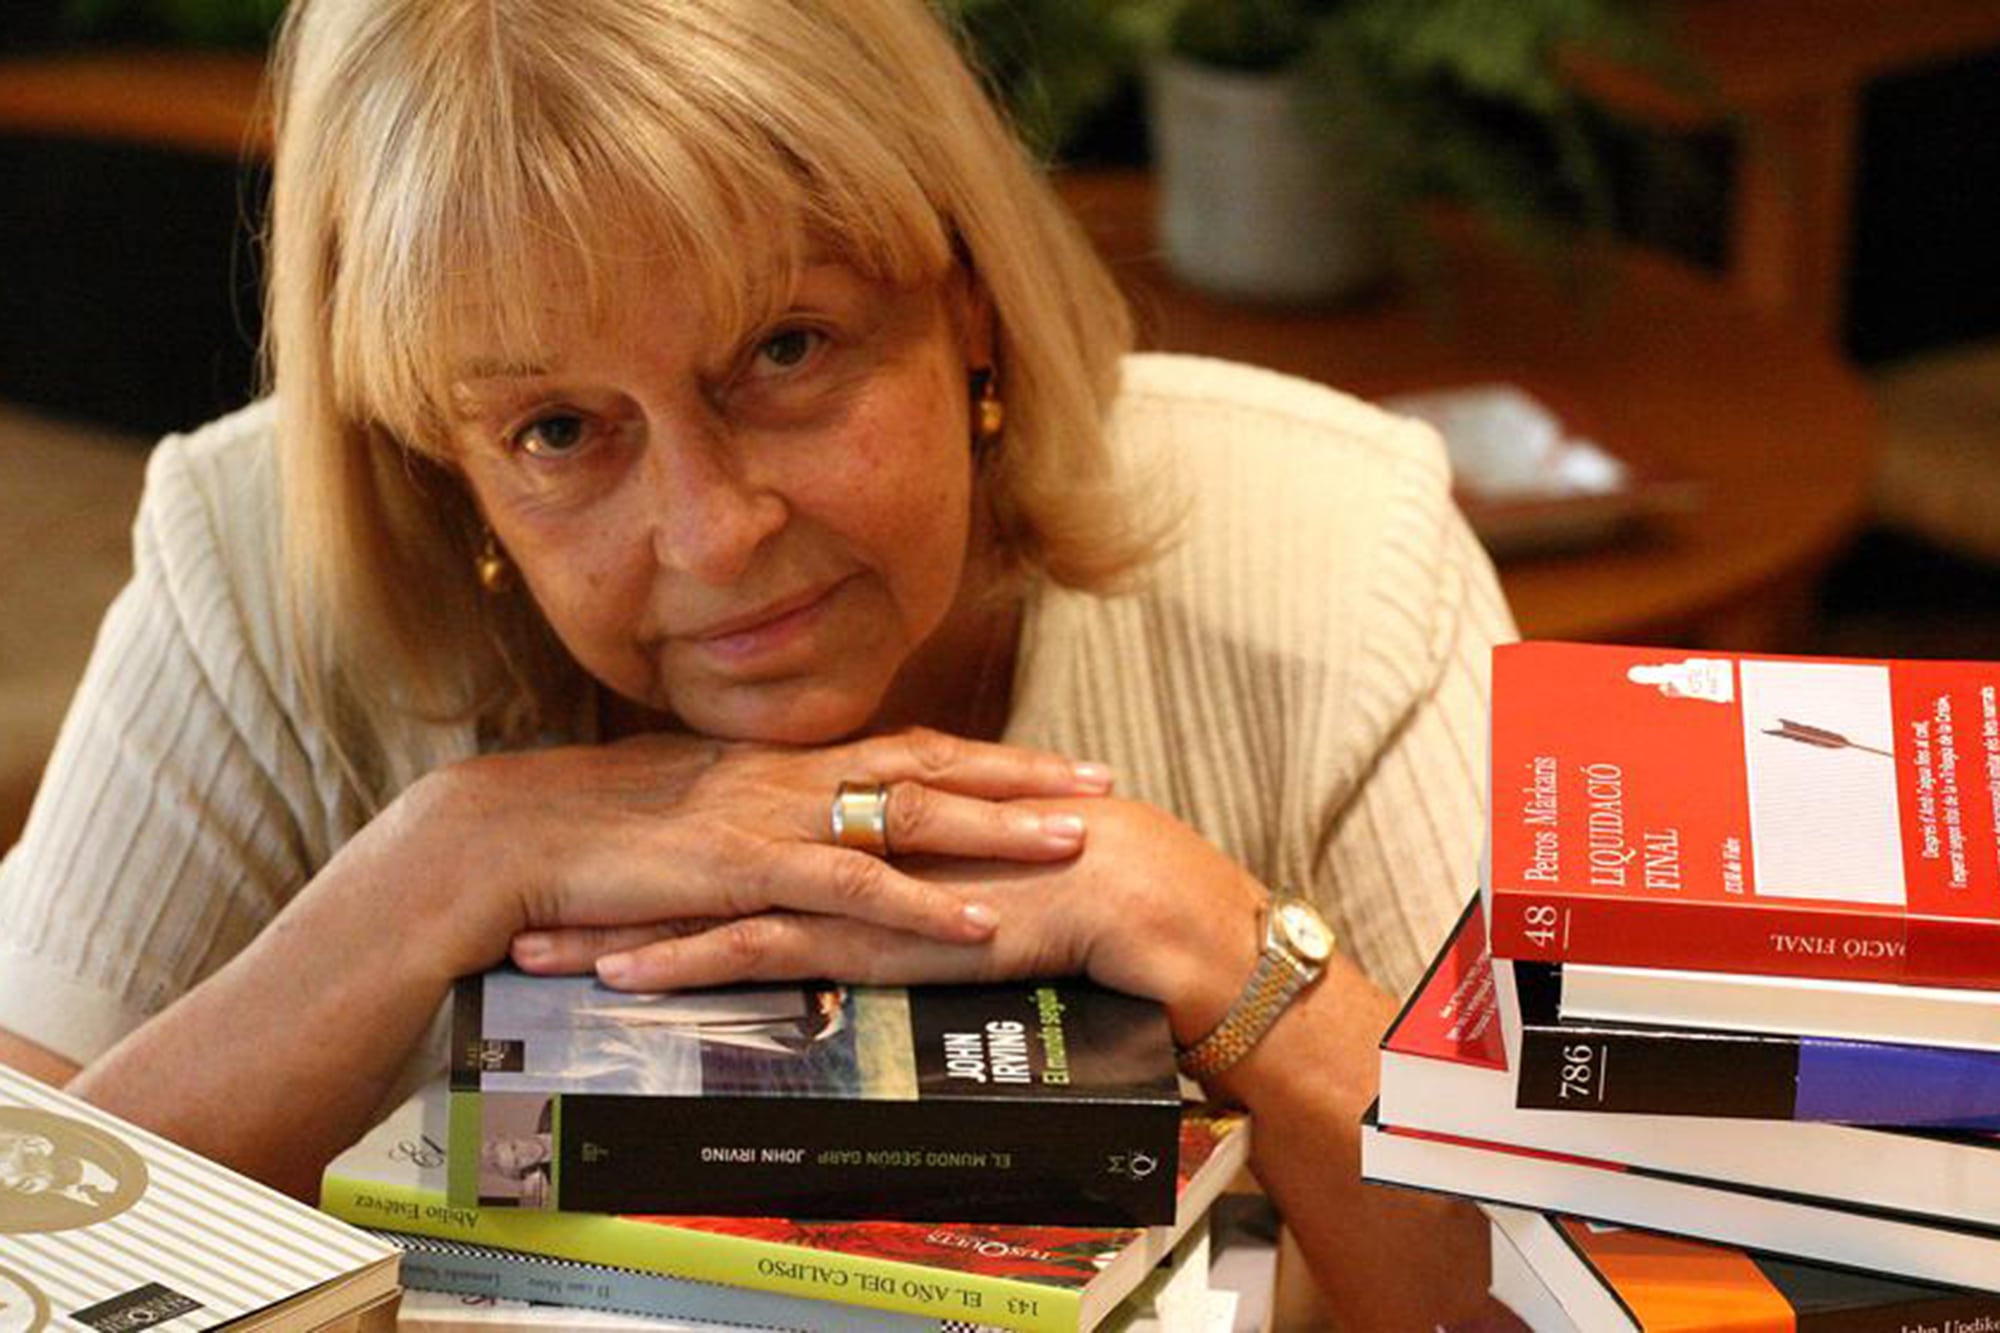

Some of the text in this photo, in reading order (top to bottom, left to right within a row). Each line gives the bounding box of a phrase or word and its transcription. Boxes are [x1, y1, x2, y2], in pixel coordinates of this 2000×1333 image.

[1579, 763, 1637, 887] LIQUIDACIÓ
[1524, 830, 1558, 883] Petros
[1643, 828, 1681, 890] FINAL
[1524, 906, 1558, 948] 48
[1770, 934, 1836, 956] FINAL
[943, 1033, 987, 1083] JOHN
[985, 1021, 1032, 1084] IRVING
[1037, 1026, 1067, 1070] mundo
[1042, 1071, 1070, 1085] El
[1559, 1044, 1594, 1101] 786
[701, 1146, 804, 1164] JOHN IRVING
[817, 1148, 863, 1165] GARP
[925, 1150, 988, 1168] MUNDO
[992, 1152, 1012, 1168] EL
[354, 1192, 480, 1229] Abilio Estévez
[757, 1257, 1039, 1317] 143 EL AÑO DEL CALIPSO
